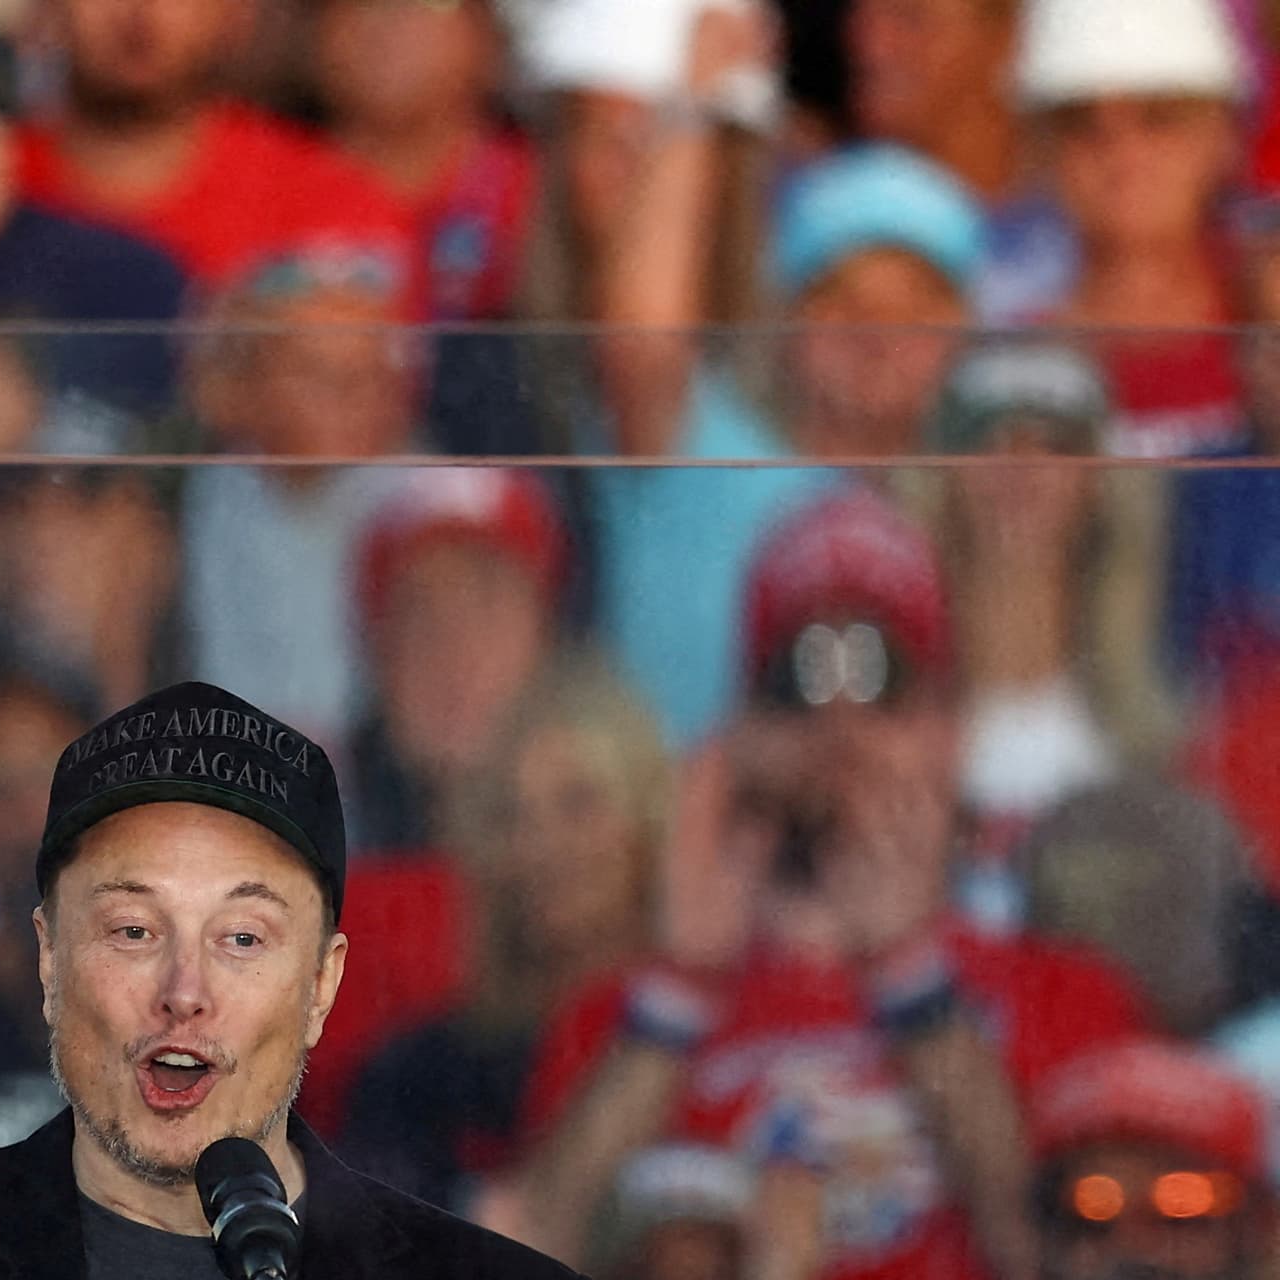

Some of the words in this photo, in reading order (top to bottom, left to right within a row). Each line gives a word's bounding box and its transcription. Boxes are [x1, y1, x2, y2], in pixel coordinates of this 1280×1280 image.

[68, 710, 157, 770] MAKE
[161, 706, 311, 777] AMERICA
[187, 747, 290, 804] AGAIN
